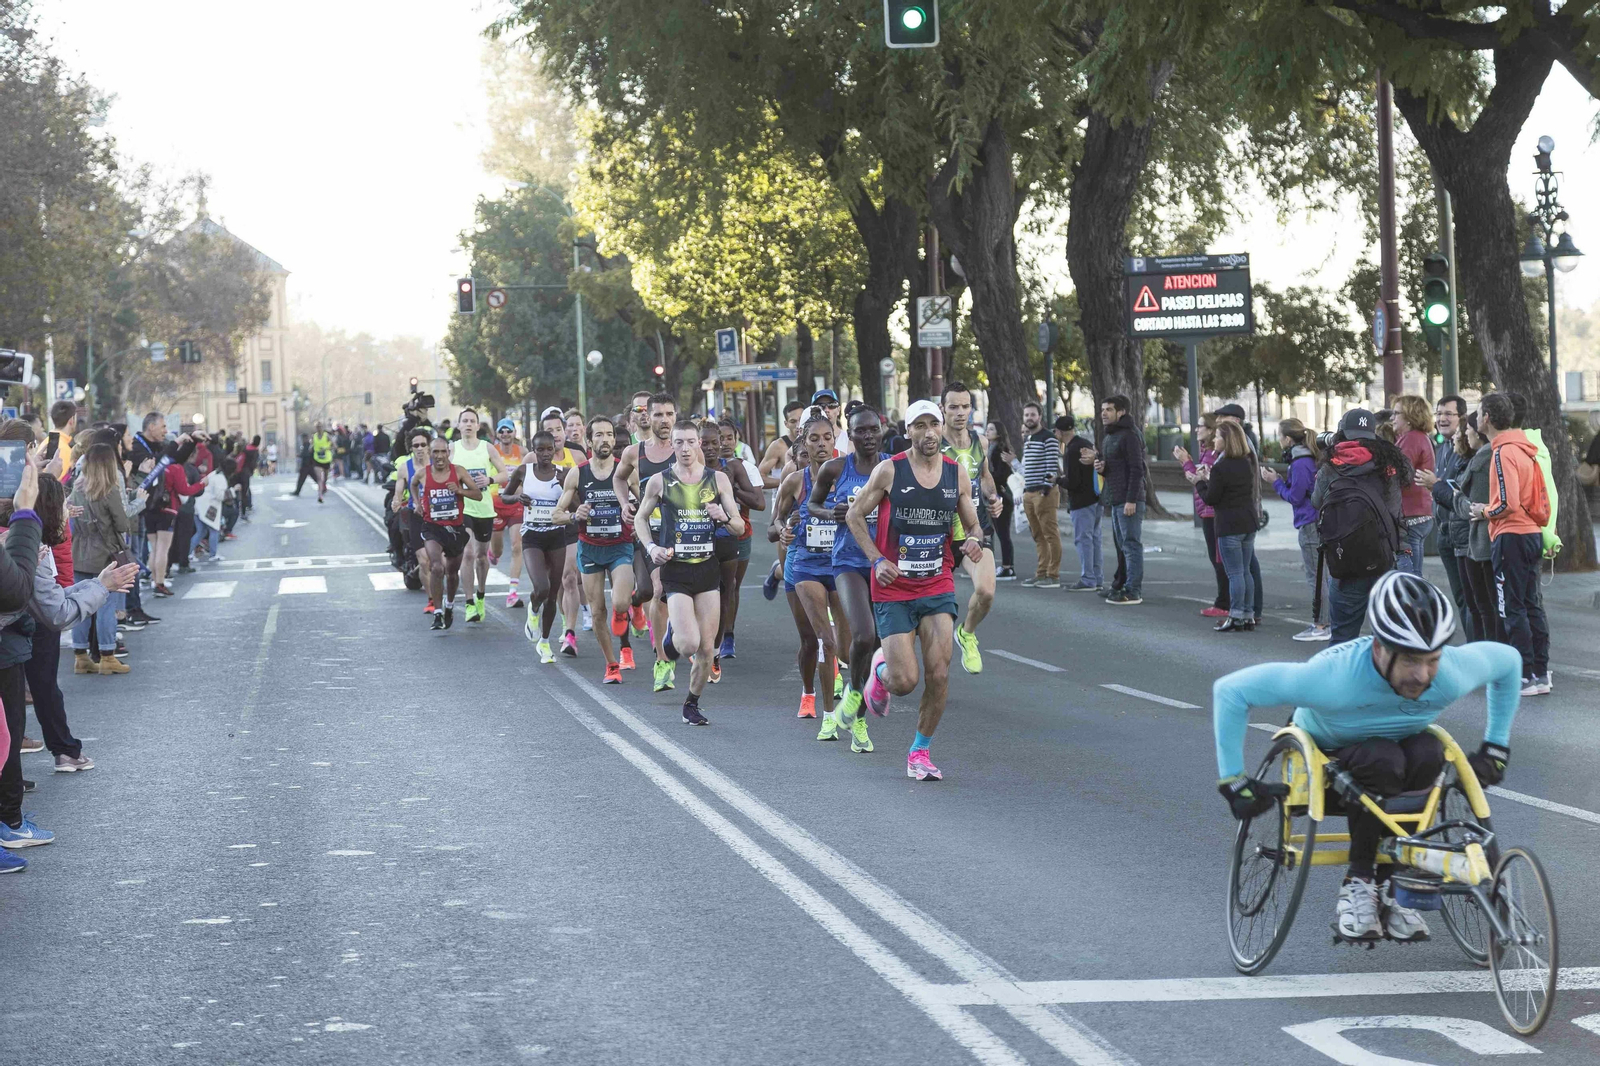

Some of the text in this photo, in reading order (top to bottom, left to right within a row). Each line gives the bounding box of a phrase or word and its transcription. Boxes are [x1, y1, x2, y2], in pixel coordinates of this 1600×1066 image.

[1133, 258, 1144, 271] P
[1164, 274, 1217, 290] ATENCION
[1161, 293, 1244, 311] PASEO DELICIAS
[1133, 316, 1173, 332] CORTADO
[1173, 314, 1202, 330] HASTA
[1202, 314, 1220, 328] LAS
[721, 334, 731, 350] P
[56, 381, 68, 397] P
[895, 507, 937, 520] ALEJANDRO
[916, 536, 941, 544] ZURICH
[920, 550, 930, 558] 27
